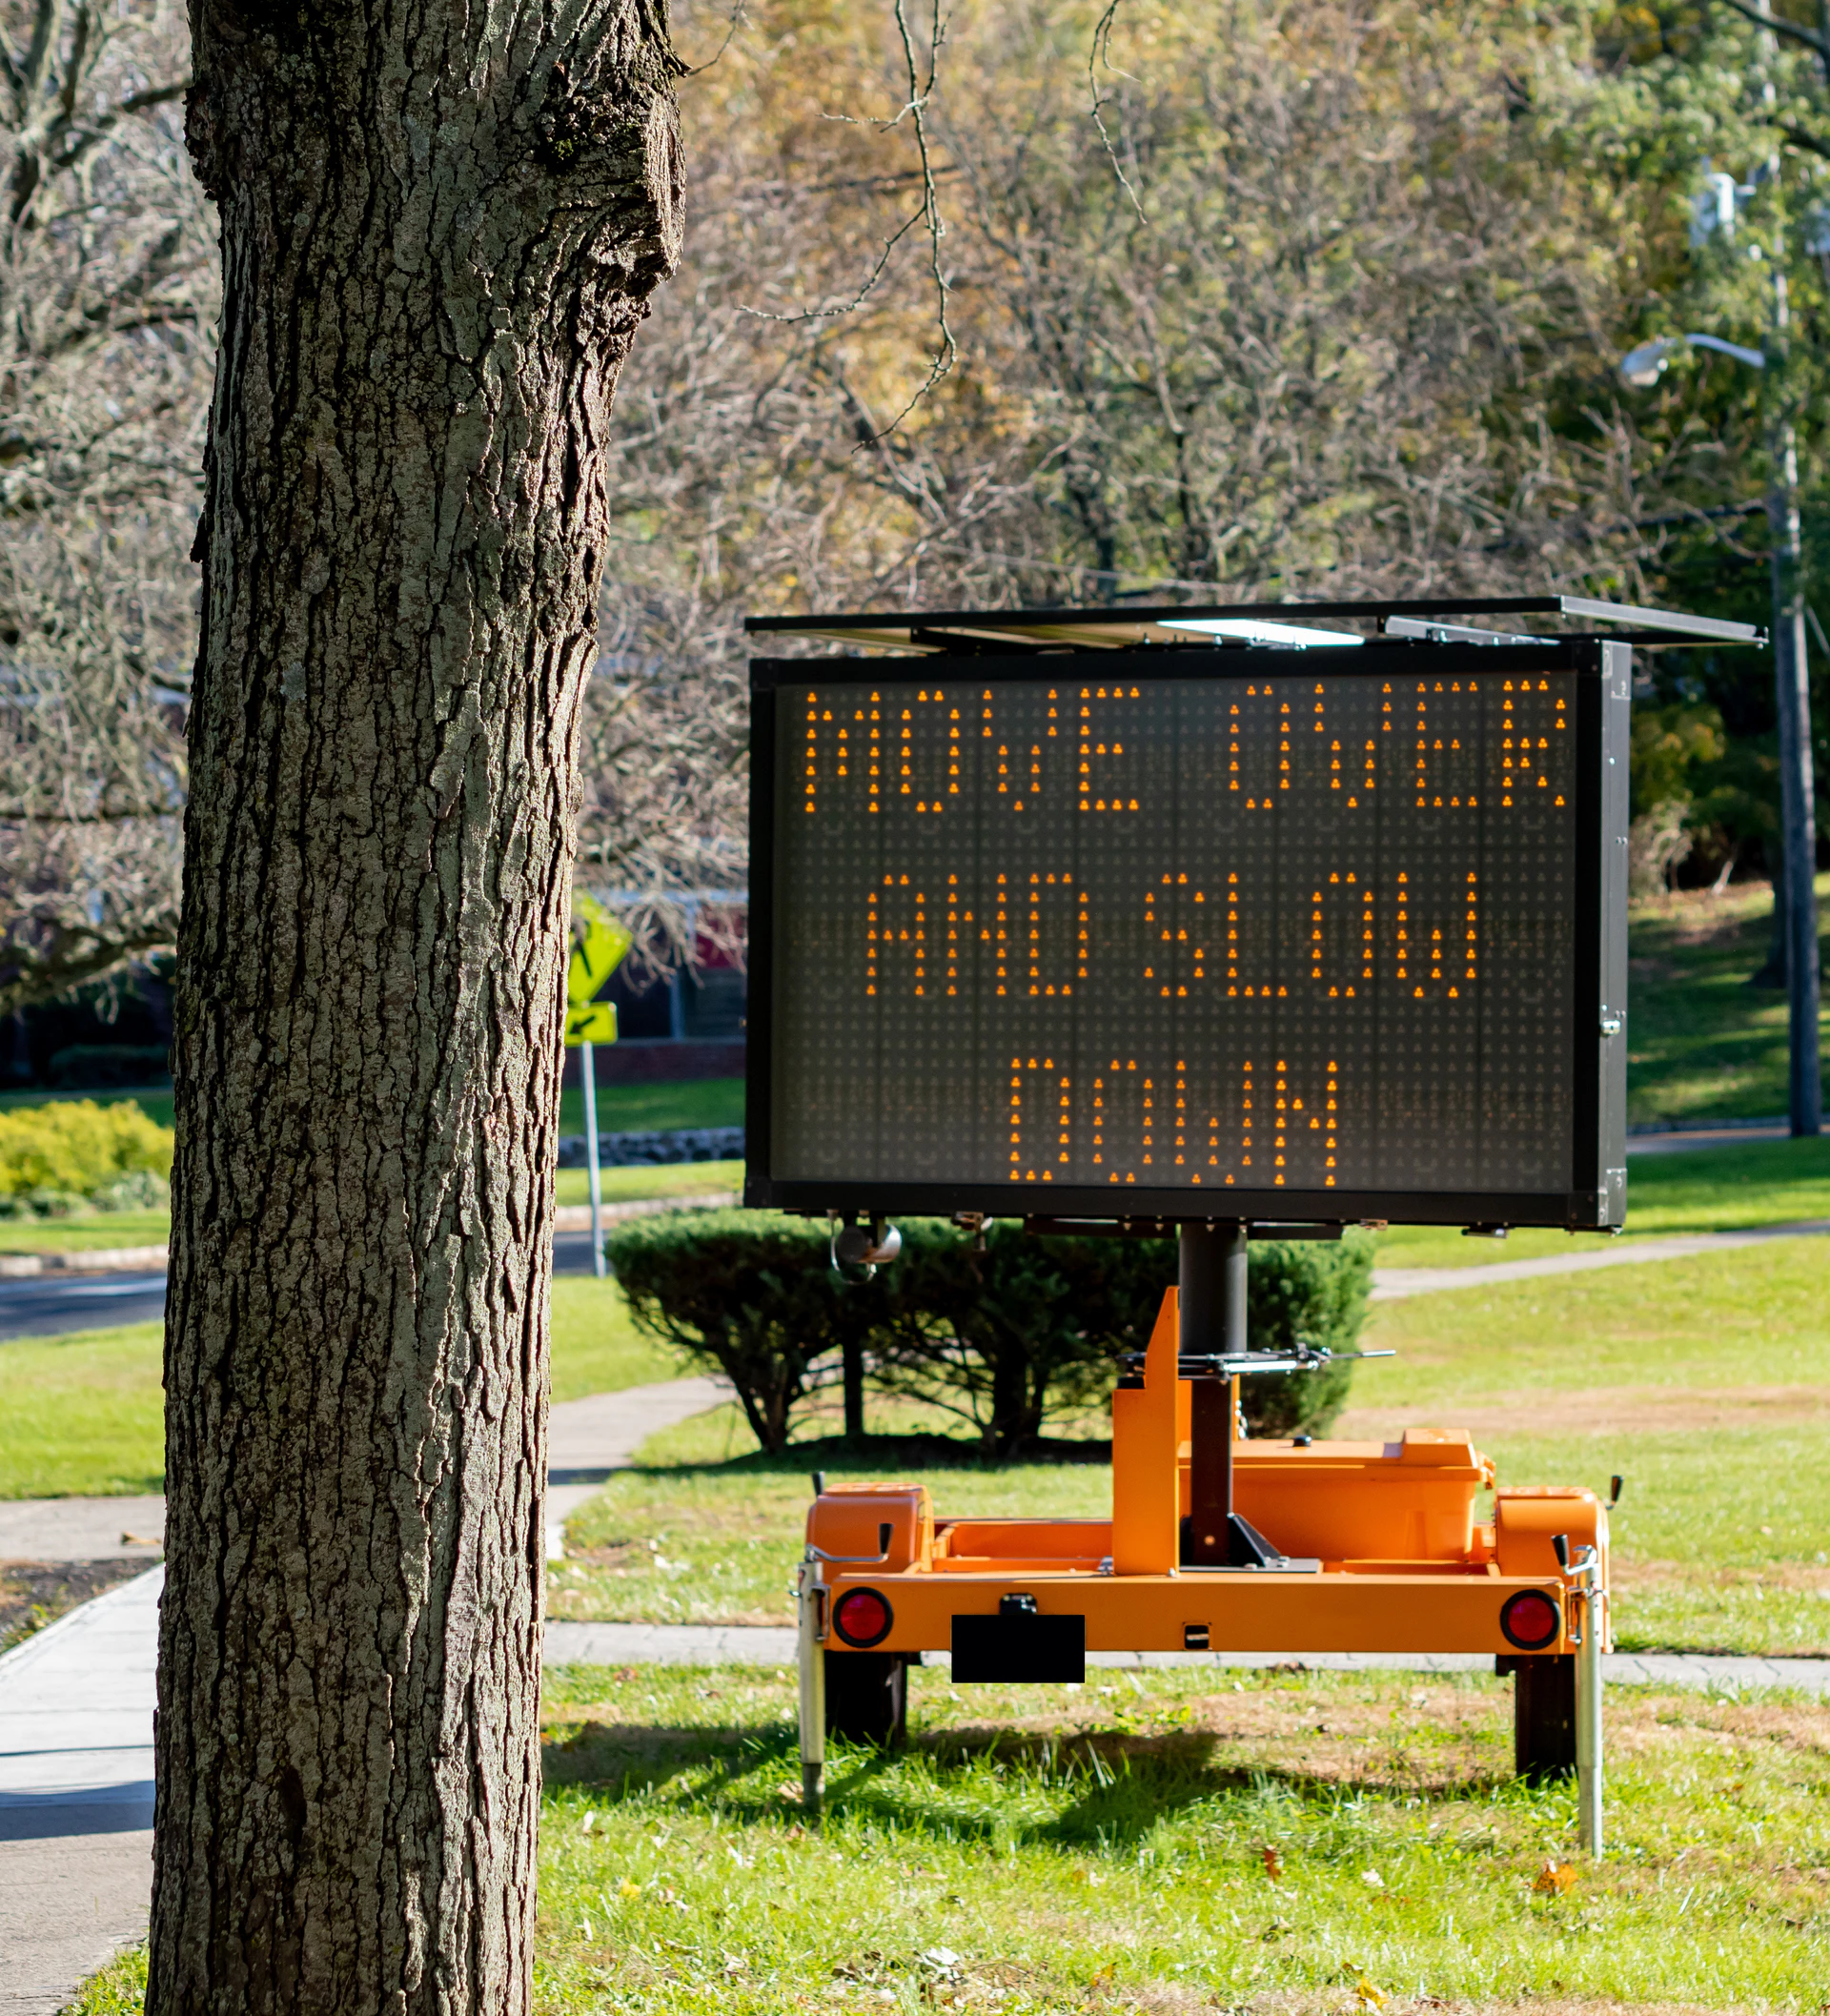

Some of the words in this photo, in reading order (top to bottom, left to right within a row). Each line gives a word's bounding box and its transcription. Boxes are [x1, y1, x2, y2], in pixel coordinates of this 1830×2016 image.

[804, 687, 1140, 813] MOVE
[1229, 680, 1566, 808] OVER
[865, 873, 1088, 996] AND
[1143, 872, 1476, 998] SLOW
[1008, 1058, 1338, 1187] DOWN
